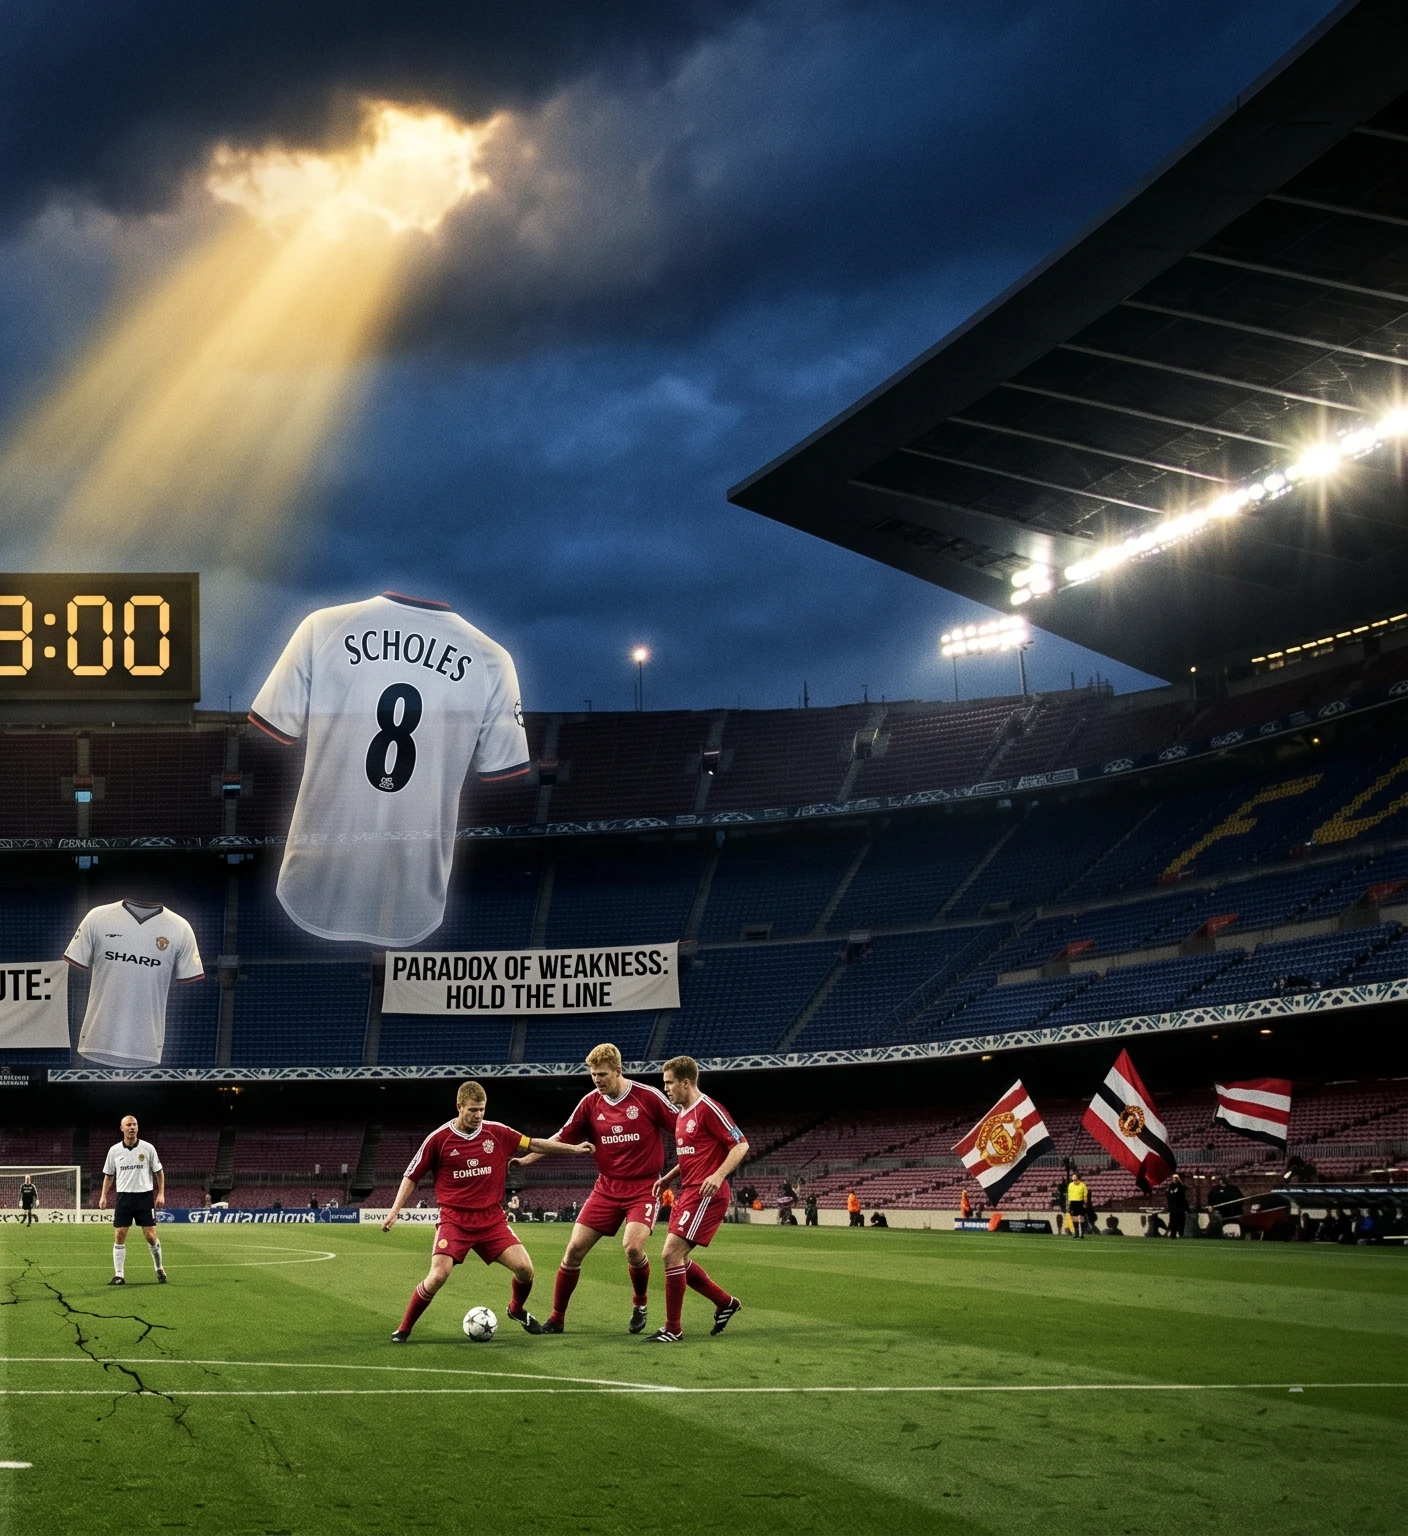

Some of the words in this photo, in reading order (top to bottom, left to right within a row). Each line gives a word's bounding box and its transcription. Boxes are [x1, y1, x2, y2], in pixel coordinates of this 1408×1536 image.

[344, 630, 473, 683] SCHOLES
[365, 682, 423, 793] 8
[104, 950, 162, 968] SHARP
[392, 956, 498, 981] PARADOX
[504, 955, 532, 981] OF
[538, 949, 669, 980] WEAKNESS:
[446, 984, 505, 1010] HOLD
[511, 983, 556, 1009] THE
[562, 981, 612, 1008] LINE
